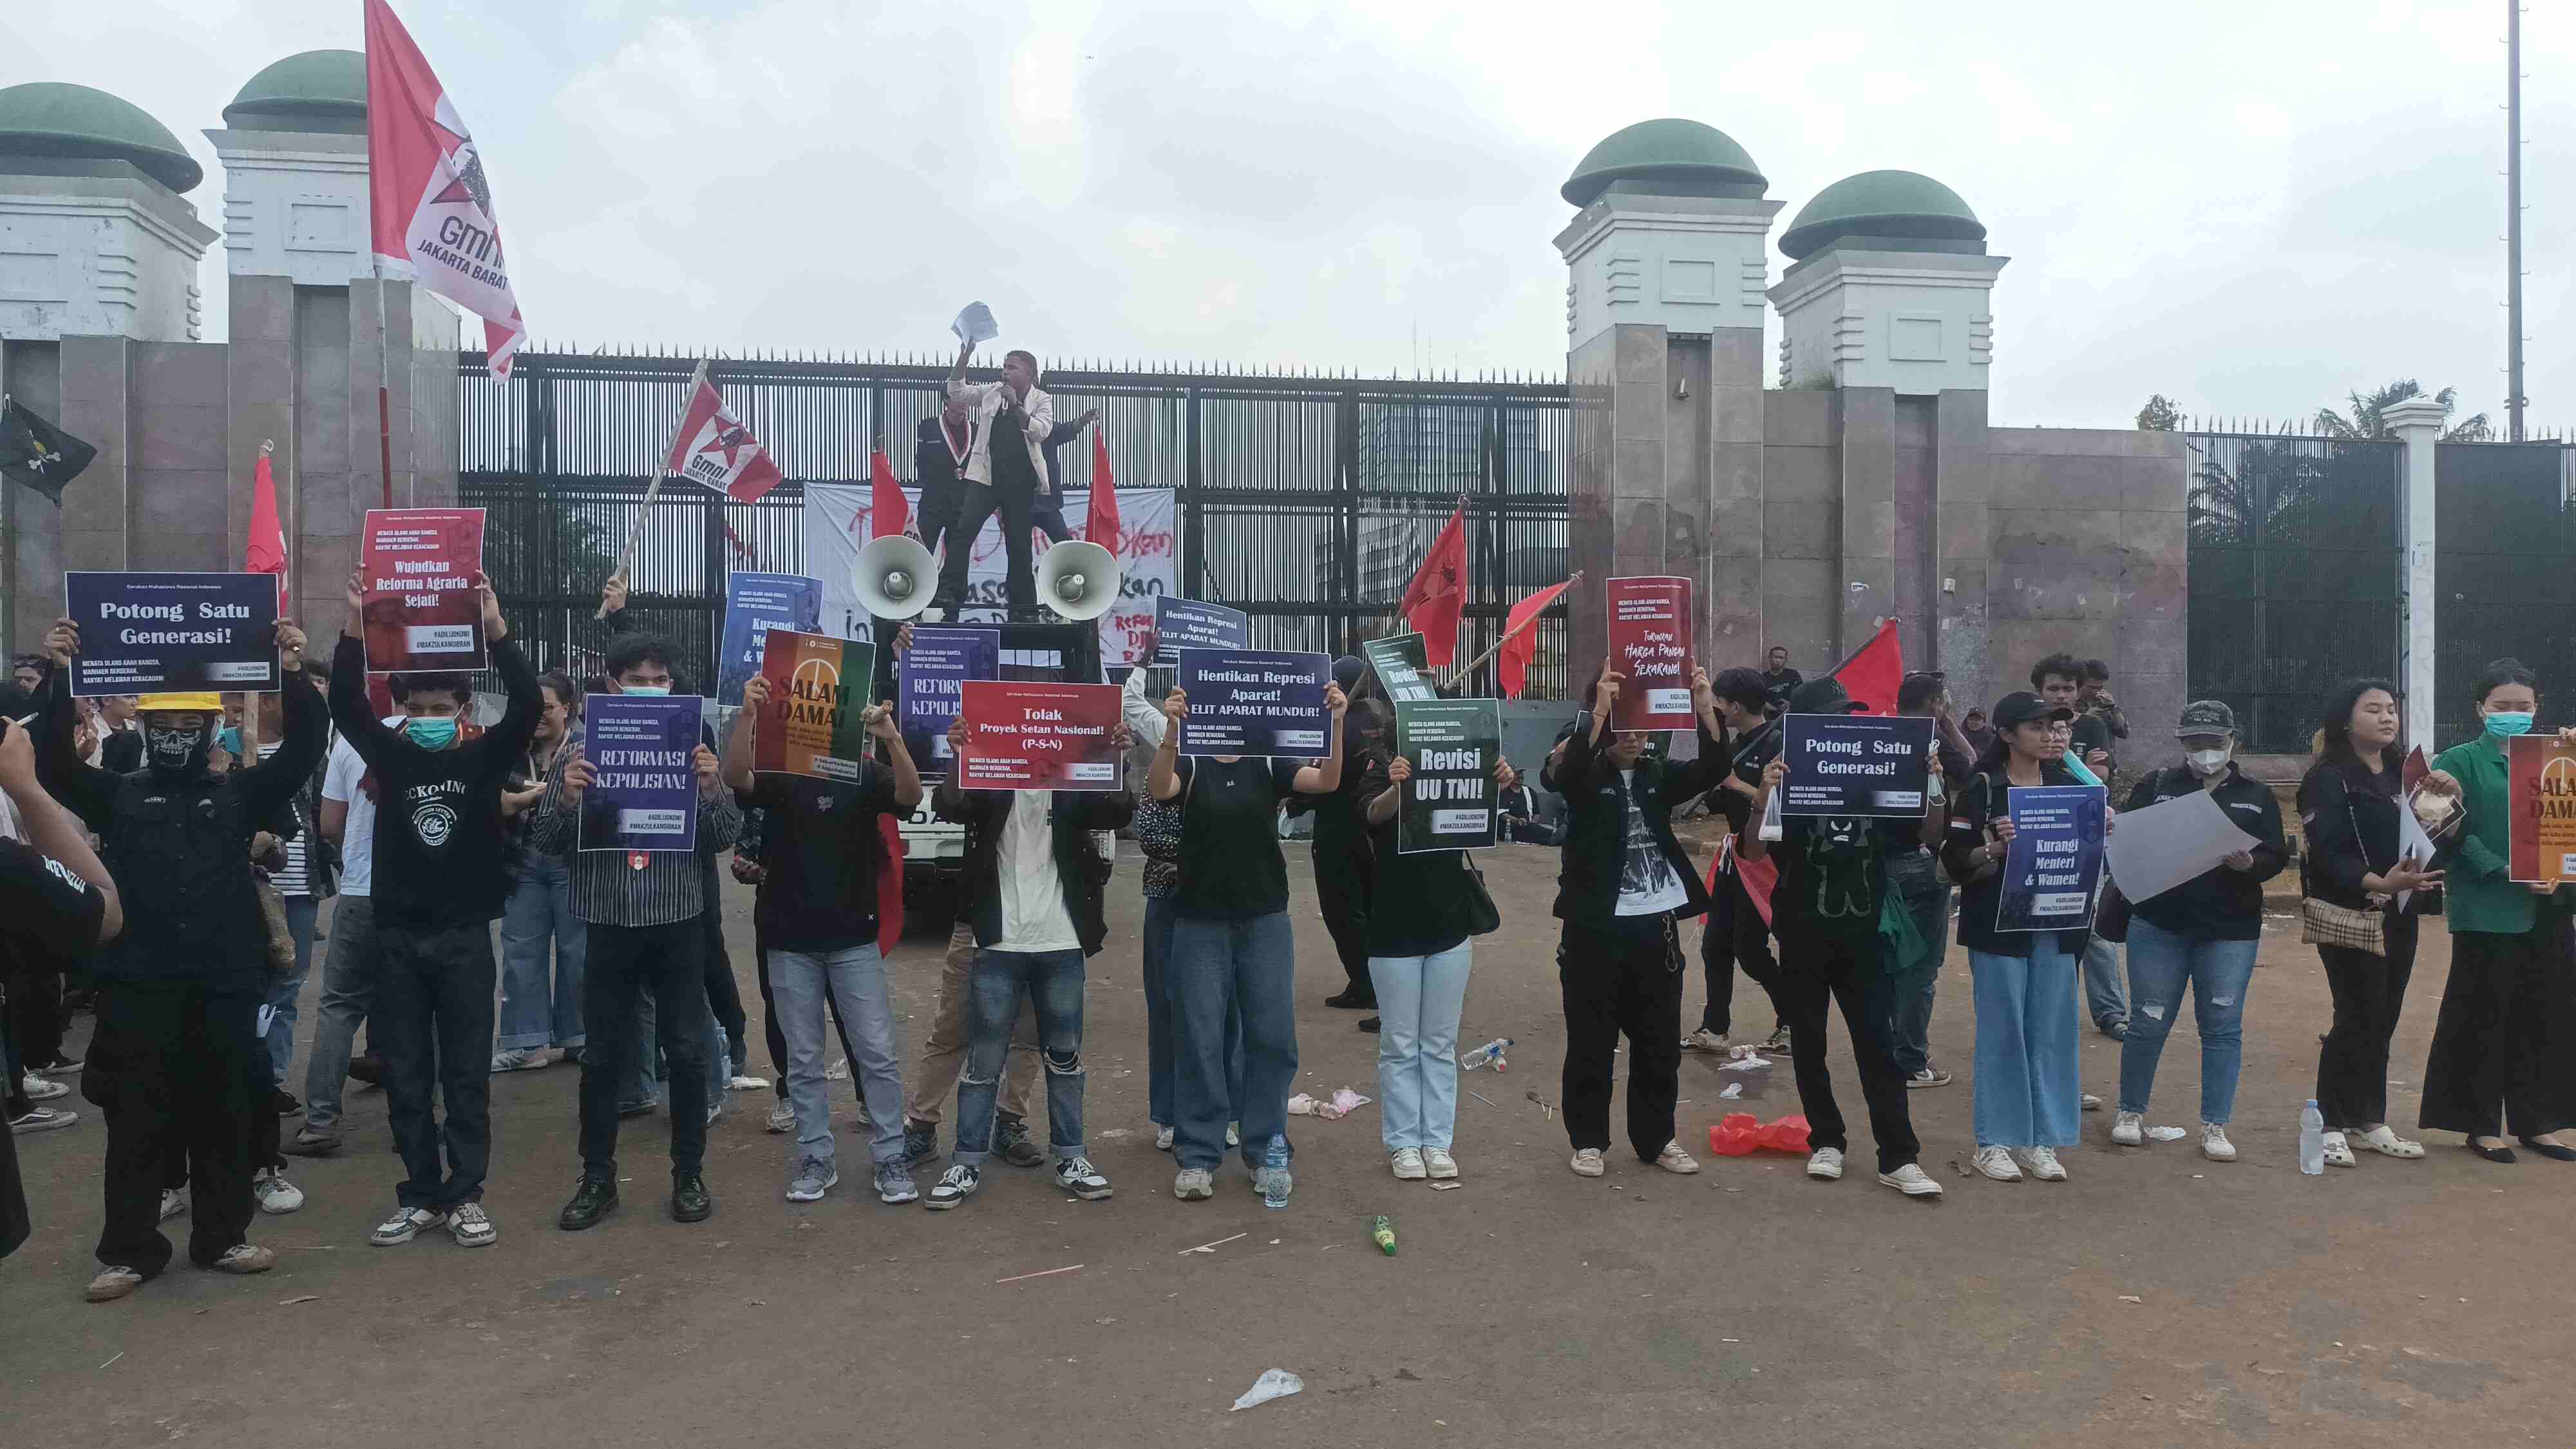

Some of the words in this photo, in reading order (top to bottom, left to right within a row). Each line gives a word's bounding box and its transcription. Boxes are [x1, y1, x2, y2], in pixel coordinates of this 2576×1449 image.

[417, 240, 471, 274] JAKARTA
[471, 265, 508, 290] BARAT
[395, 561, 450, 574] Wujudkan
[376, 578, 422, 591] Reforma
[426, 577, 468, 591] Agraria
[405, 594, 439, 607] Sejati!
[100, 602, 184, 622] Potong
[199, 602, 250, 619] Satu
[1166, 610, 1205, 623] Hentikan
[1208, 616, 1237, 629] Represi
[120, 628, 232, 644] Generasi!
[1187, 623, 1218, 636] Aparat!
[1180, 632, 1208, 643] APARAT
[1209, 637, 1240, 649] MUNDUR!
[743, 650, 752, 662] &
[1198, 669, 1259, 683] Hentikan
[1264, 671, 1315, 686] Represi
[1388, 667, 1419, 683] Revisi
[779, 676, 851, 706] SALAM
[1231, 688, 1281, 703] Aparat!
[777, 700, 846, 728] DAMAI
[1023, 708, 1063, 721] Tolak
[1191, 704, 1216, 715] ELIT
[1218, 705, 1262, 715] APARAT
[1266, 706, 1320, 717] MUNDUR!
[980, 723, 1018, 735] Proyek
[1021, 724, 1051, 734] Setan
[1054, 724, 1104, 735] Nasional!
[1022, 739, 1063, 751] (P-S-N)
[1806, 739, 1862, 756] Potong
[1873, 741, 1911, 755] Satu
[600, 750, 686, 766] REFORMASI
[1420, 748, 1481, 771] Revisi
[1817, 760, 1896, 775] Generasi!
[596, 773, 687, 789] KEPOLISIAN!
[1416, 779, 1442, 800] UU
[1446, 778, 1484, 800] TNI!
[2036, 838, 2079, 853] Kurangi
[2035, 857, 2074, 869] Menteri
[2025, 874, 2034, 886] &
[2038, 873, 2080, 886] Wamen!
